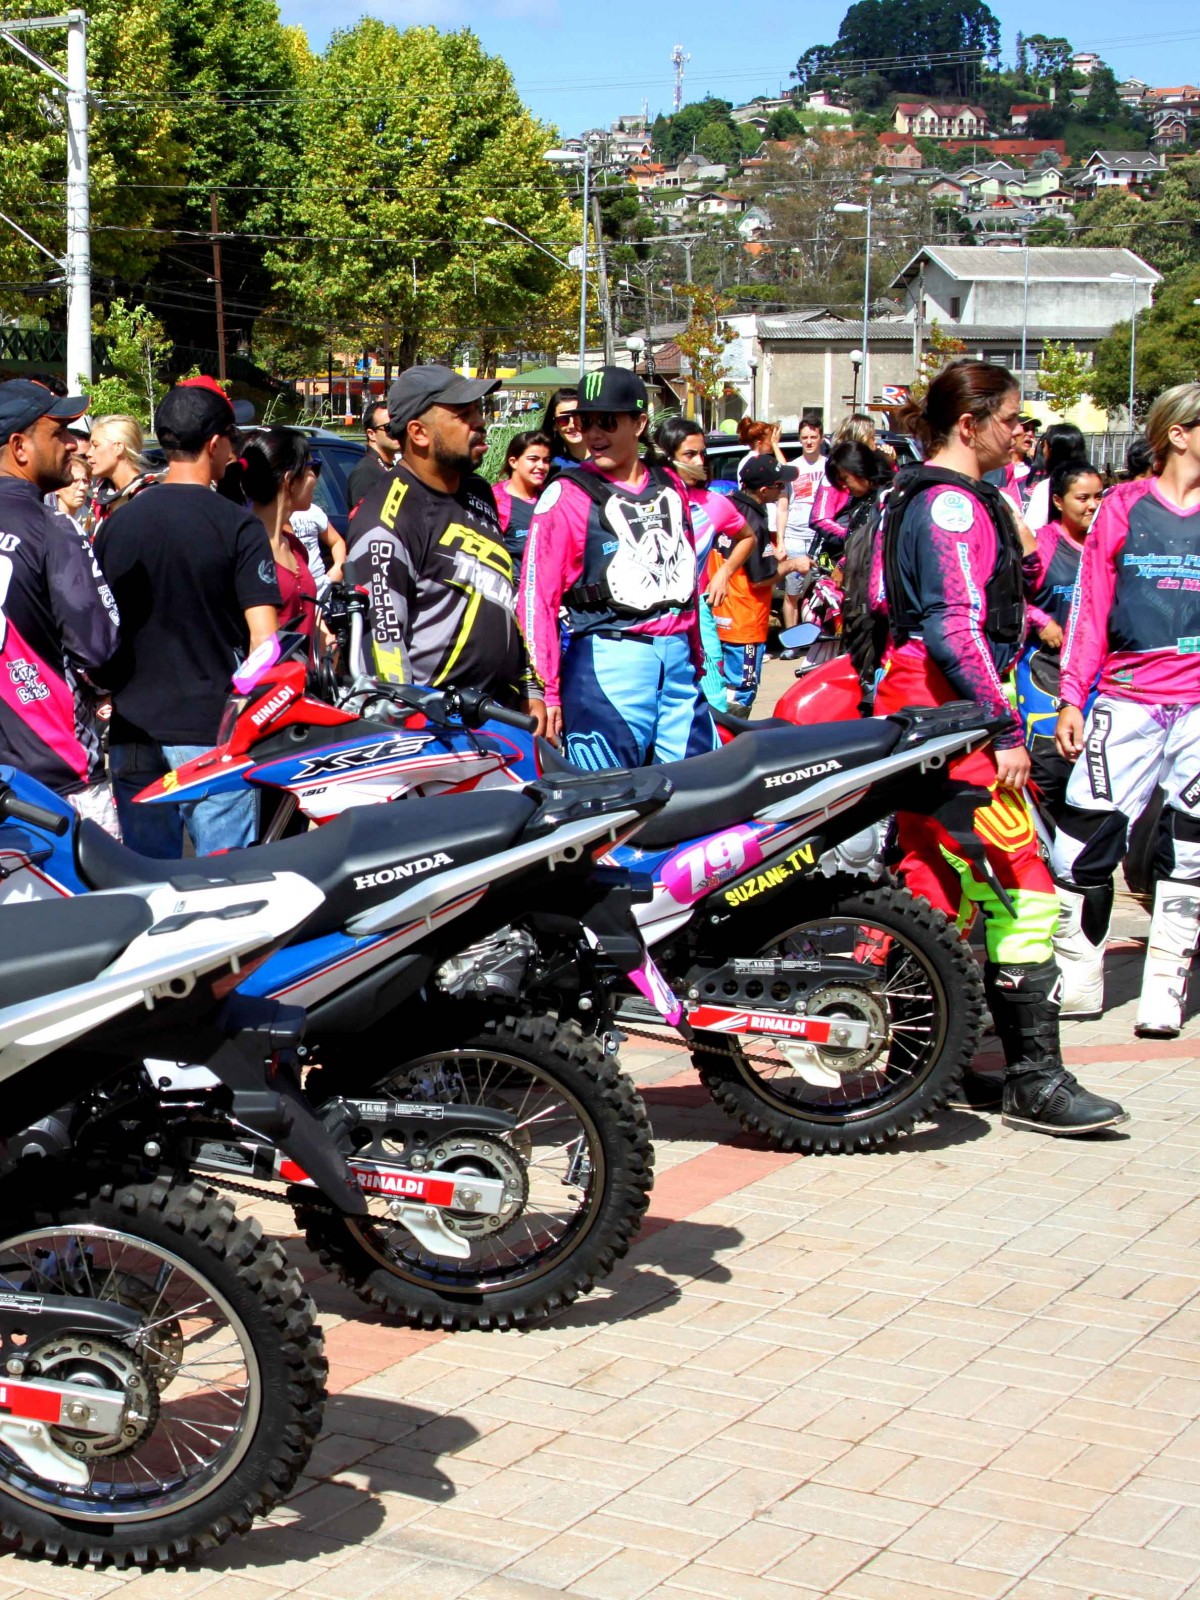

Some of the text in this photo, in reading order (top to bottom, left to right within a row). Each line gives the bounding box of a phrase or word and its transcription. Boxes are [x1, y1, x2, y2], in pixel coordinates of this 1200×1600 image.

[371, 542, 388, 642] CAMPOS DO
[763, 759, 843, 789] HONDA
[1184, 778, 1200, 802] PR
[353, 852, 454, 890] HONDA
[676, 831, 746, 895] 79
